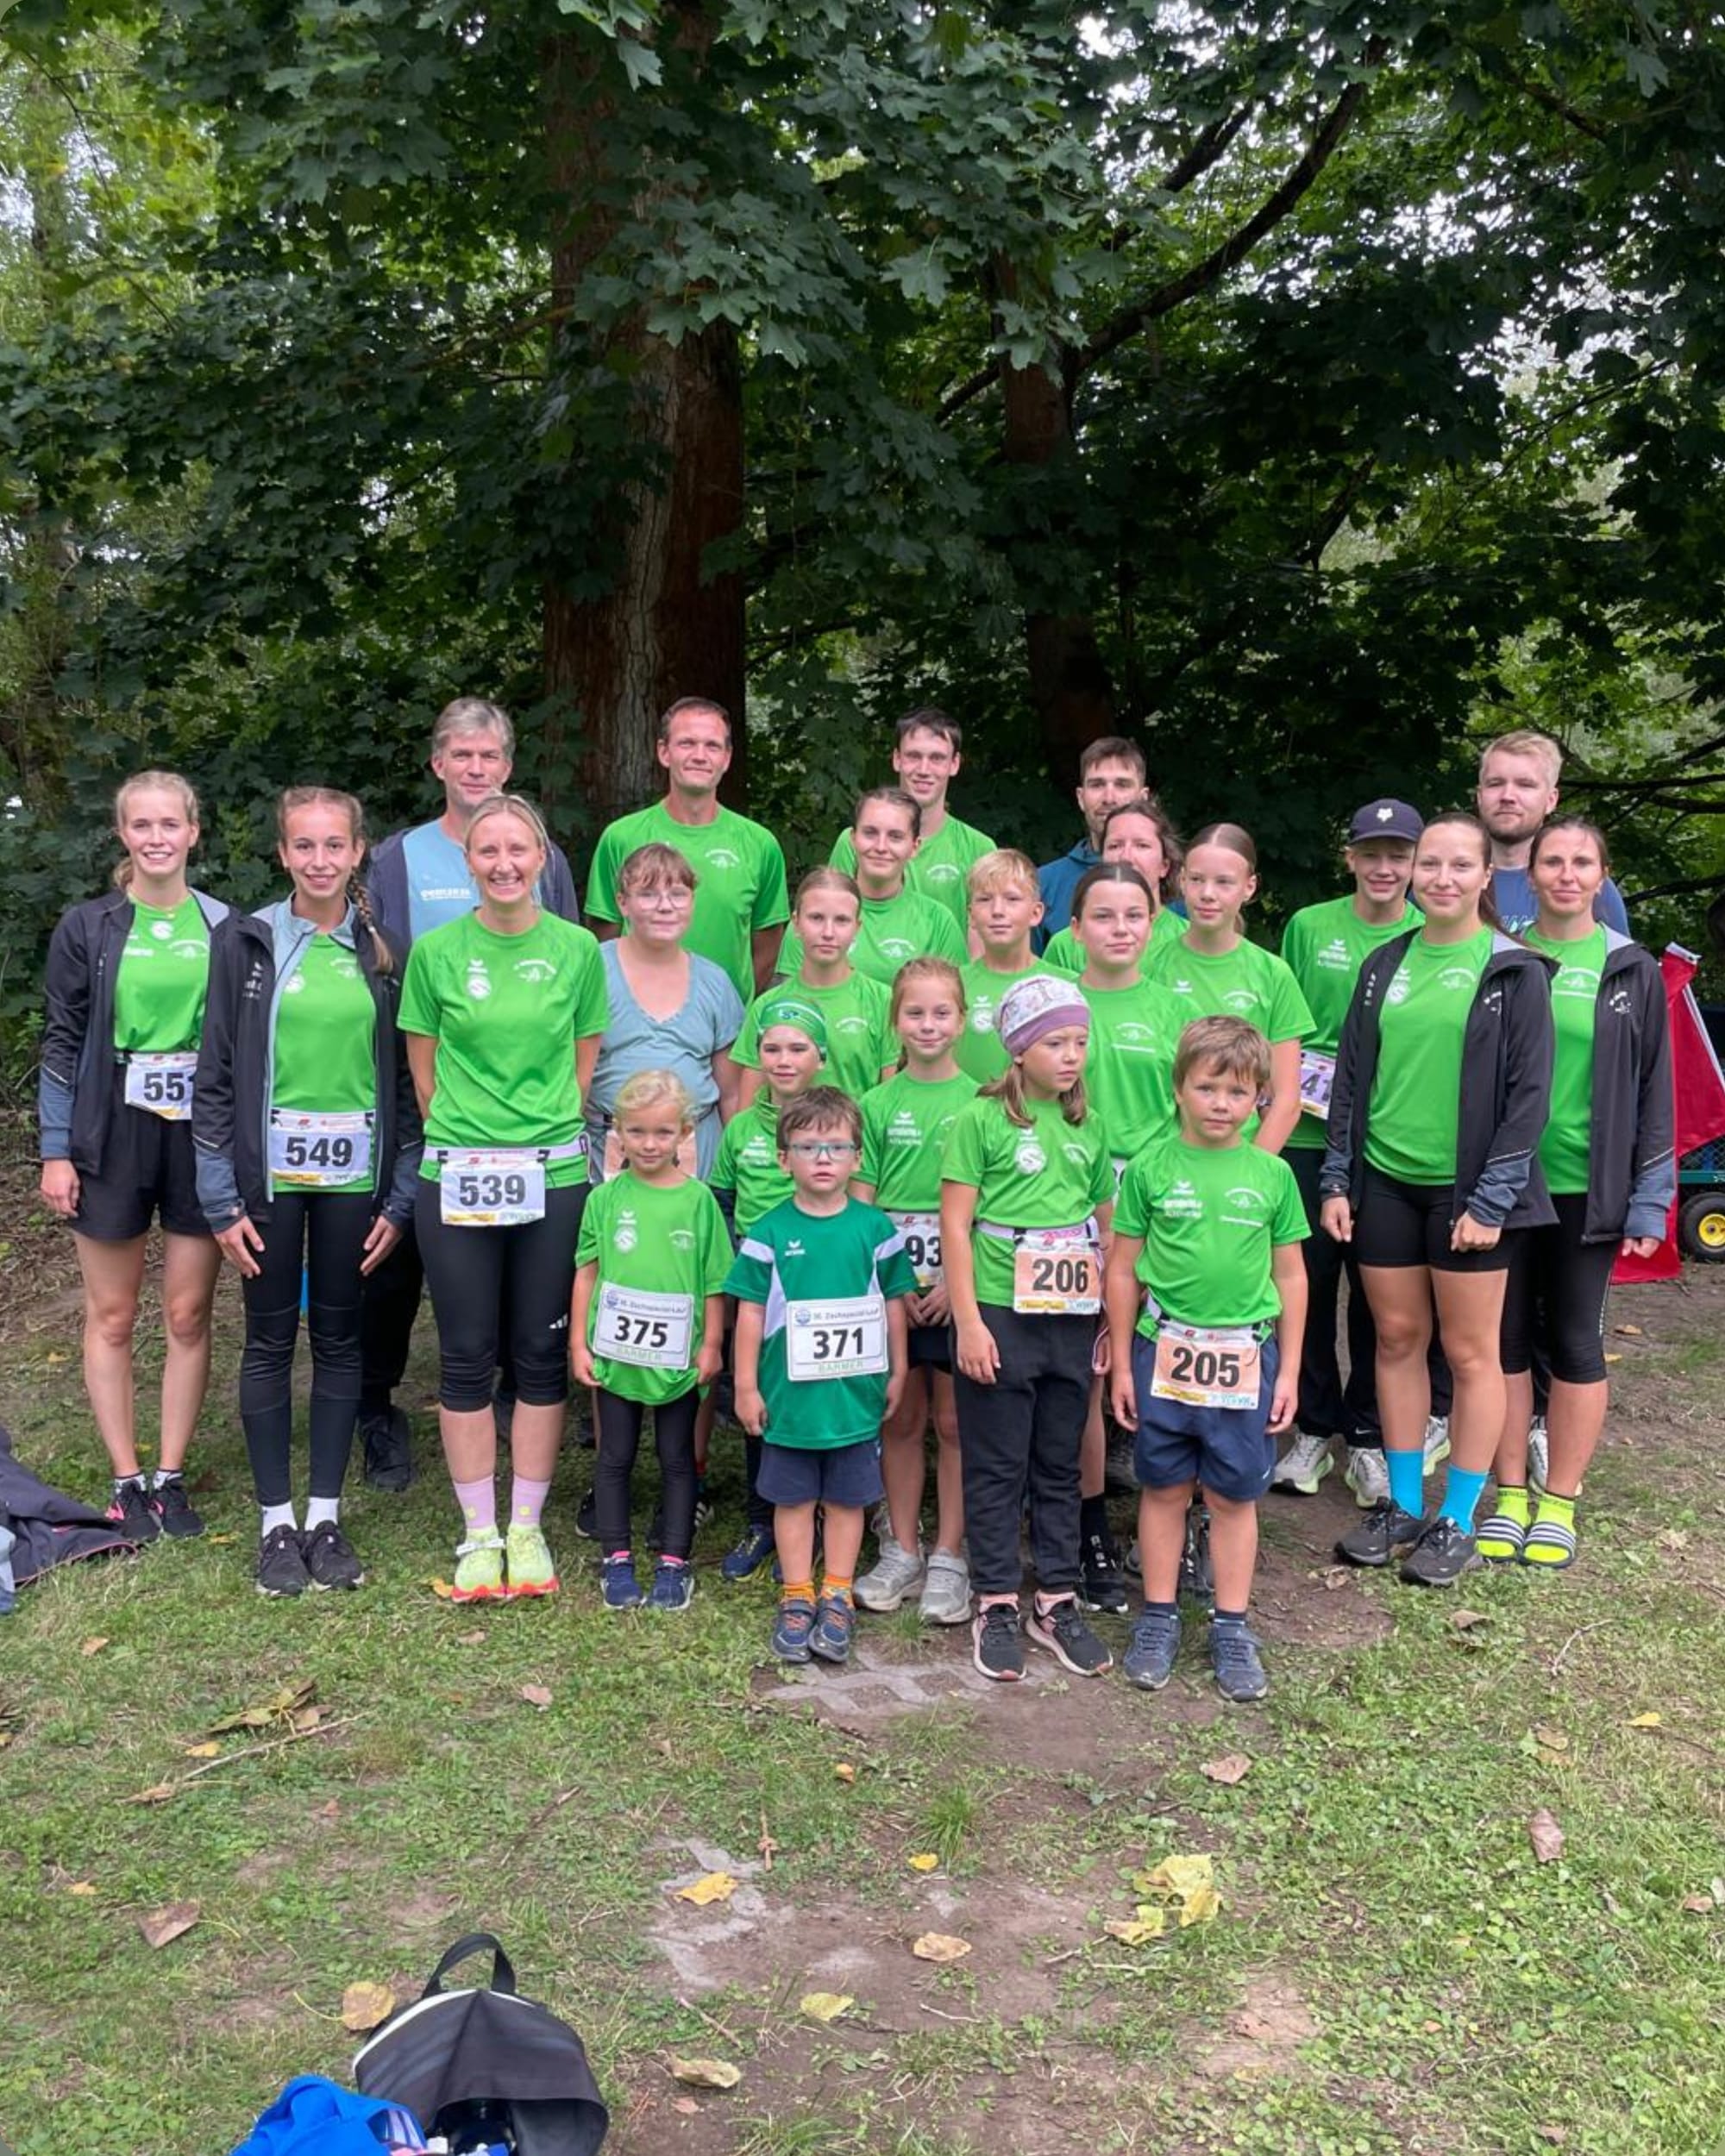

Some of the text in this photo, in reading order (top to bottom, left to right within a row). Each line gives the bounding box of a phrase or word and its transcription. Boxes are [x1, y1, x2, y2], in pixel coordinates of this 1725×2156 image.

[143, 1072, 194, 1101] 55
[285, 1137, 353, 1167] 549
[459, 1174, 525, 1206] 539
[1032, 1258, 1088, 1293] 206
[615, 1315, 668, 1348] 375
[813, 1326, 862, 1359] 371
[818, 1359, 864, 1374] BARMER
[1170, 1346, 1239, 1388] 205
